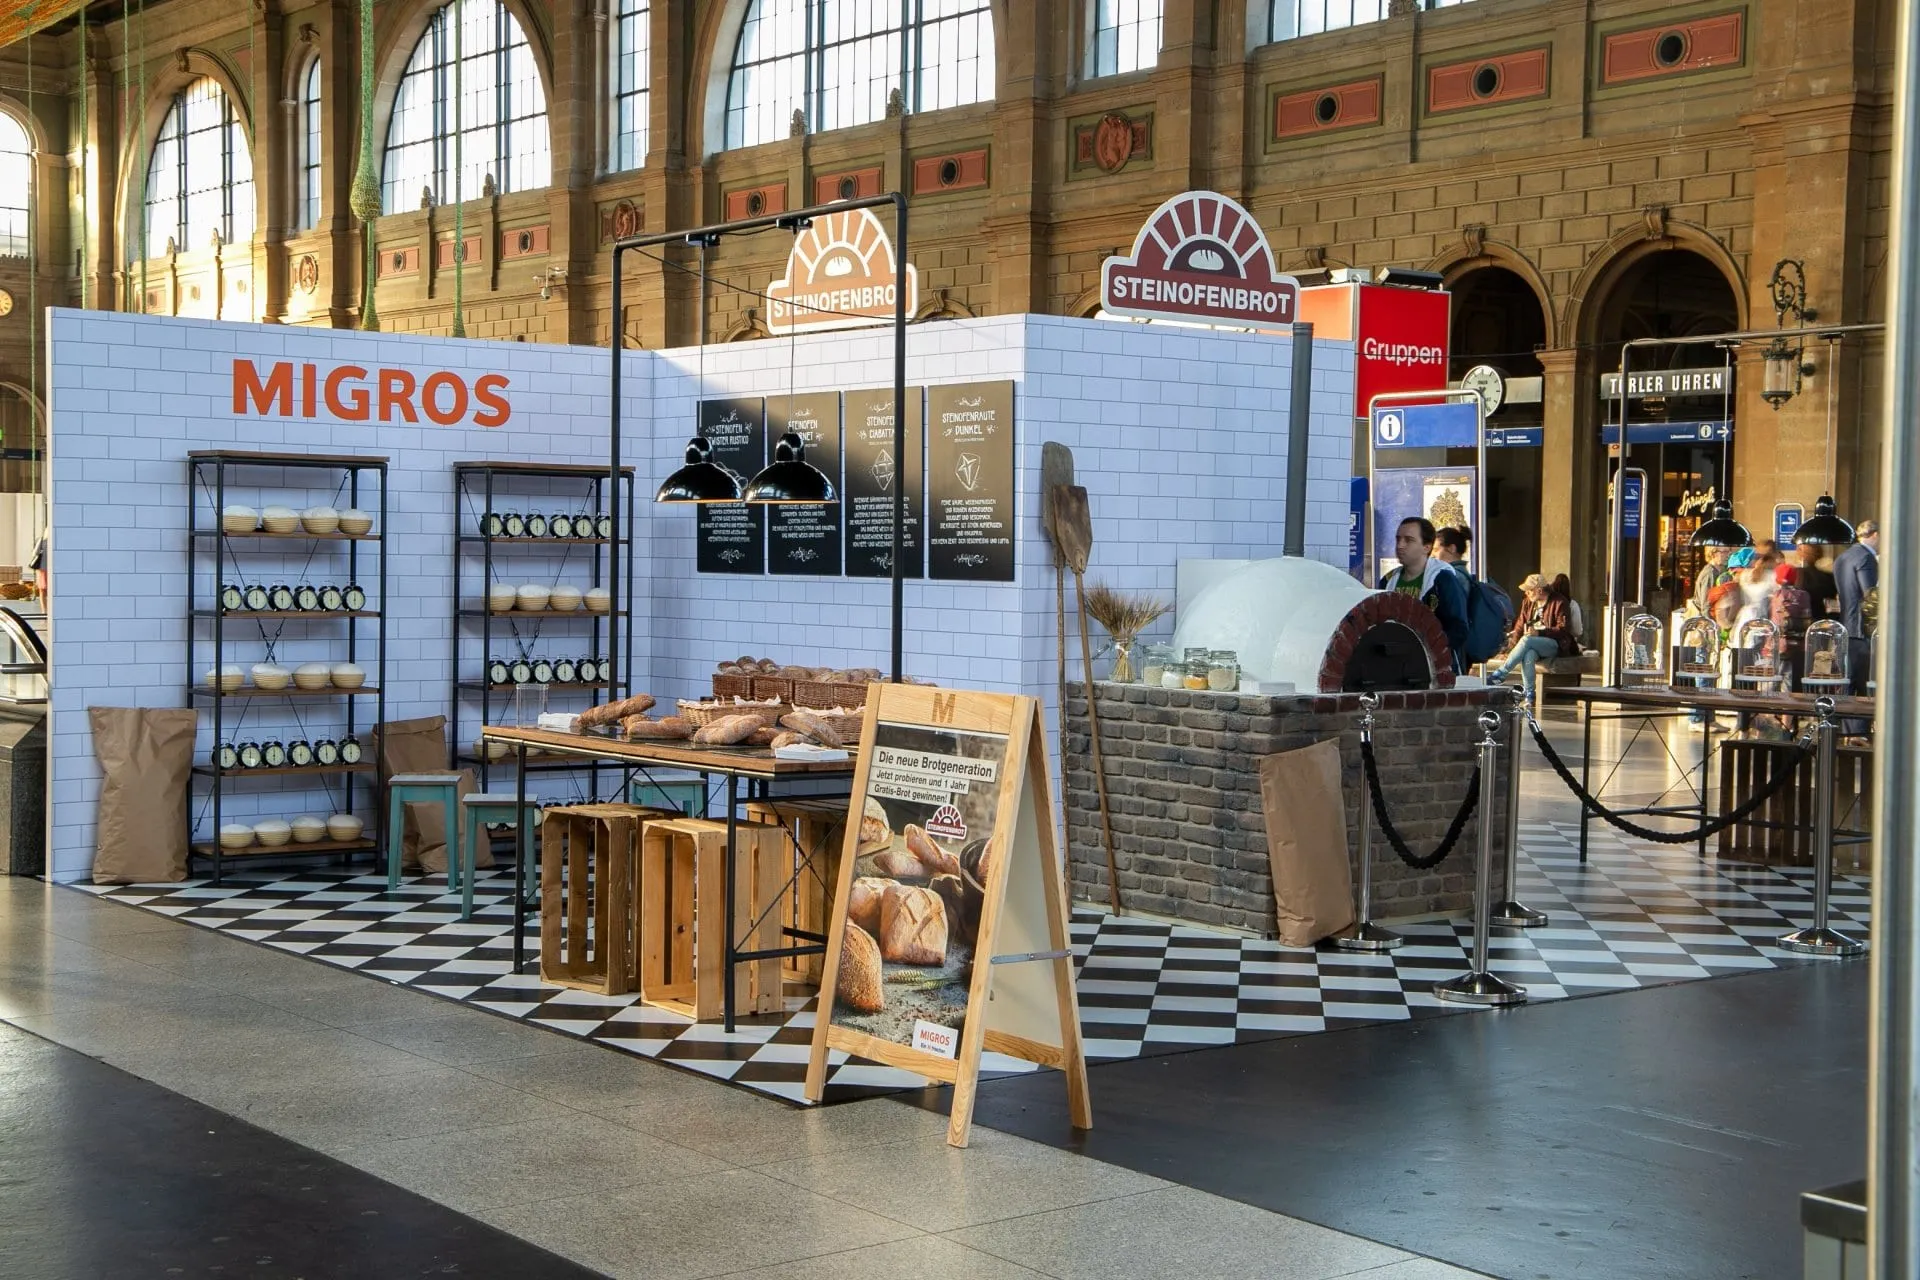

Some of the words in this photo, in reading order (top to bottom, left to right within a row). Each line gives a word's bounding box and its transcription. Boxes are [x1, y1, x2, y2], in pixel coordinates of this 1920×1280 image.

[774, 283, 898, 318] STEINOFENBRO
[1113, 275, 1291, 315] STEINOFENBROT
[1364, 337, 1442, 366] Gruppen
[233, 358, 511, 427] MIGROS
[1671, 372, 1722, 392] UHREN
[787, 419, 818, 431] STEINOFEN
[942, 410, 996, 424] STEINOFENRAUTE
[715, 424, 743, 434] STEINOFEN
[955, 424, 983, 436] DUNKEL
[931, 692, 956, 724] M
[879, 750, 894, 764] Die
[896, 755, 919, 767] neue
[921, 756, 992, 778] Brotgeneration
[876, 769, 893, 780] Jetzt
[894, 772, 927, 785] probieren
[928, 777, 942, 788] und
[944, 779, 948, 788] 1
[950, 779, 967, 791] Jahr
[874, 783, 911, 797] Gratis-Brot
[911, 790, 948, 803] gewinnen!
[920, 1029, 950, 1046] MIGROS
